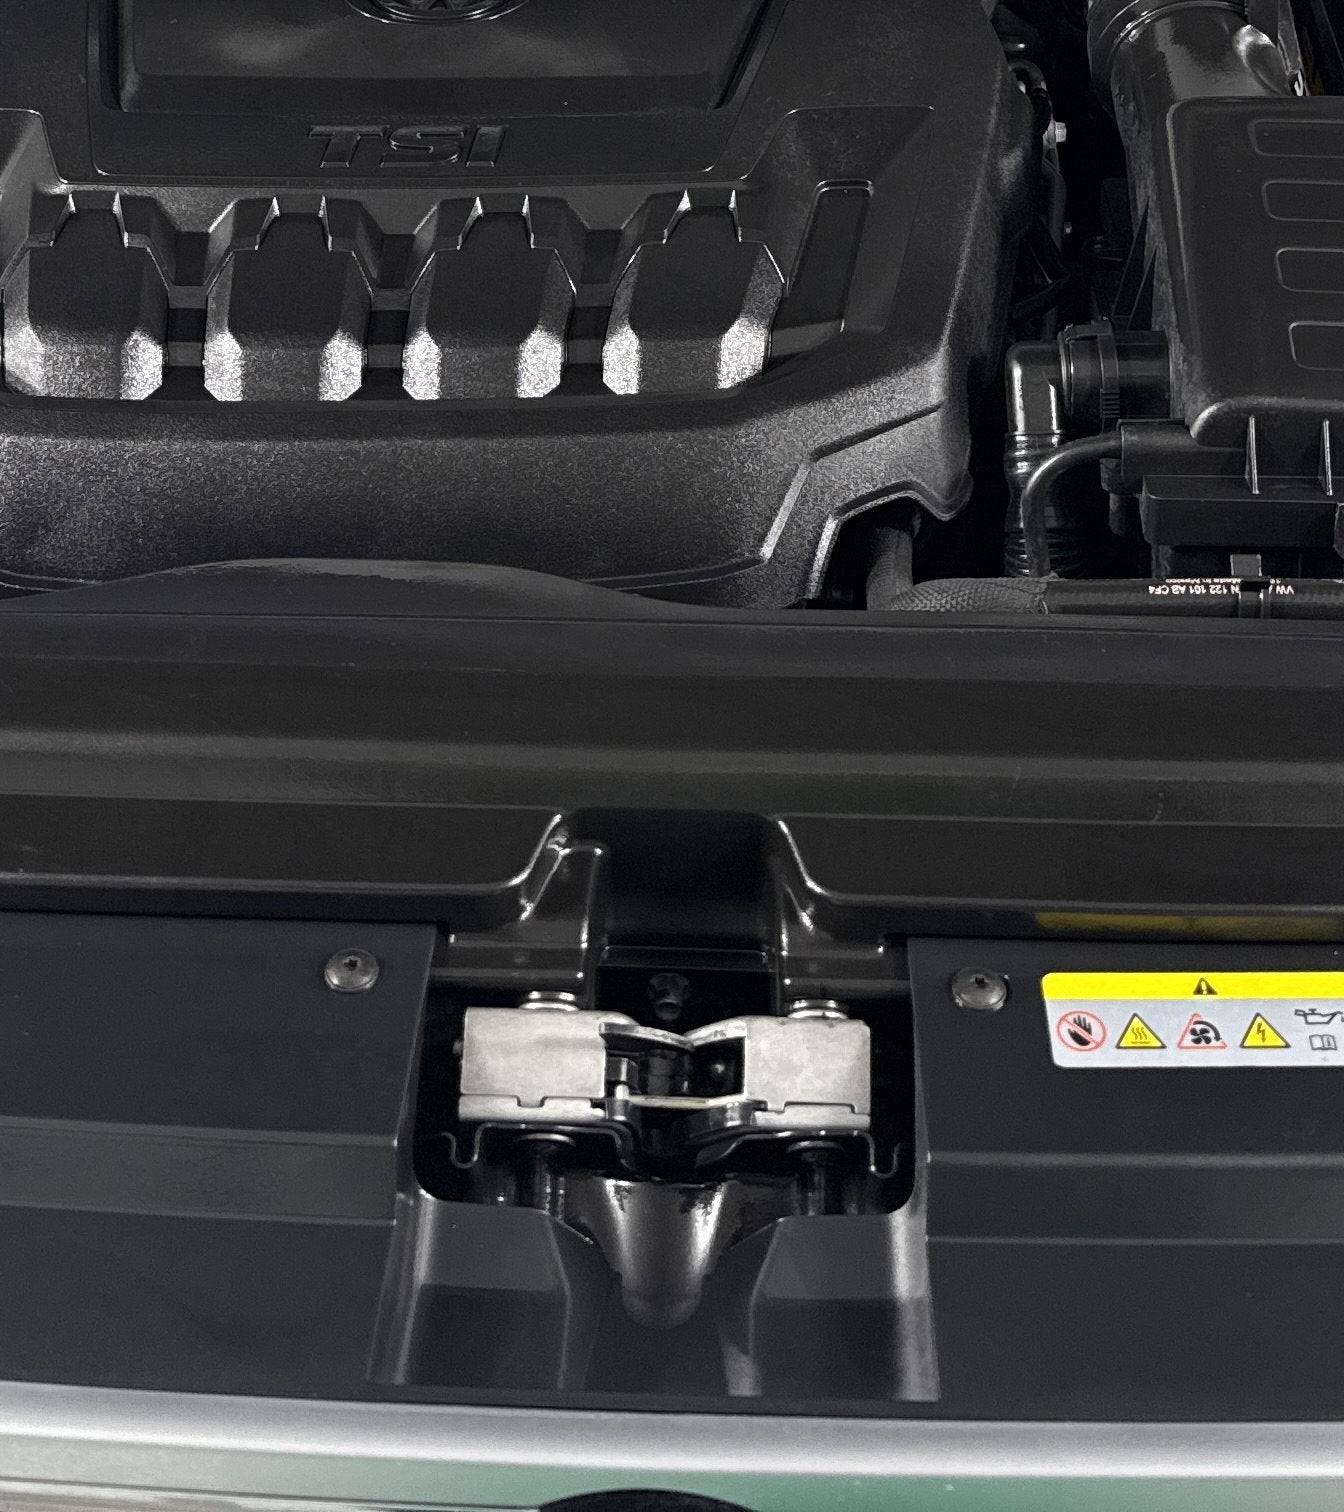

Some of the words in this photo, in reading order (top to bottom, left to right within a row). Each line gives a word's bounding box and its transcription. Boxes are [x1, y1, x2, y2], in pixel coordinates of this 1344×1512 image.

[307, 124, 508, 168] TSI
[1149, 585, 1169, 594] CF4
[1190, 585, 1206, 594] 101
[1209, 585, 1228, 594] 122
